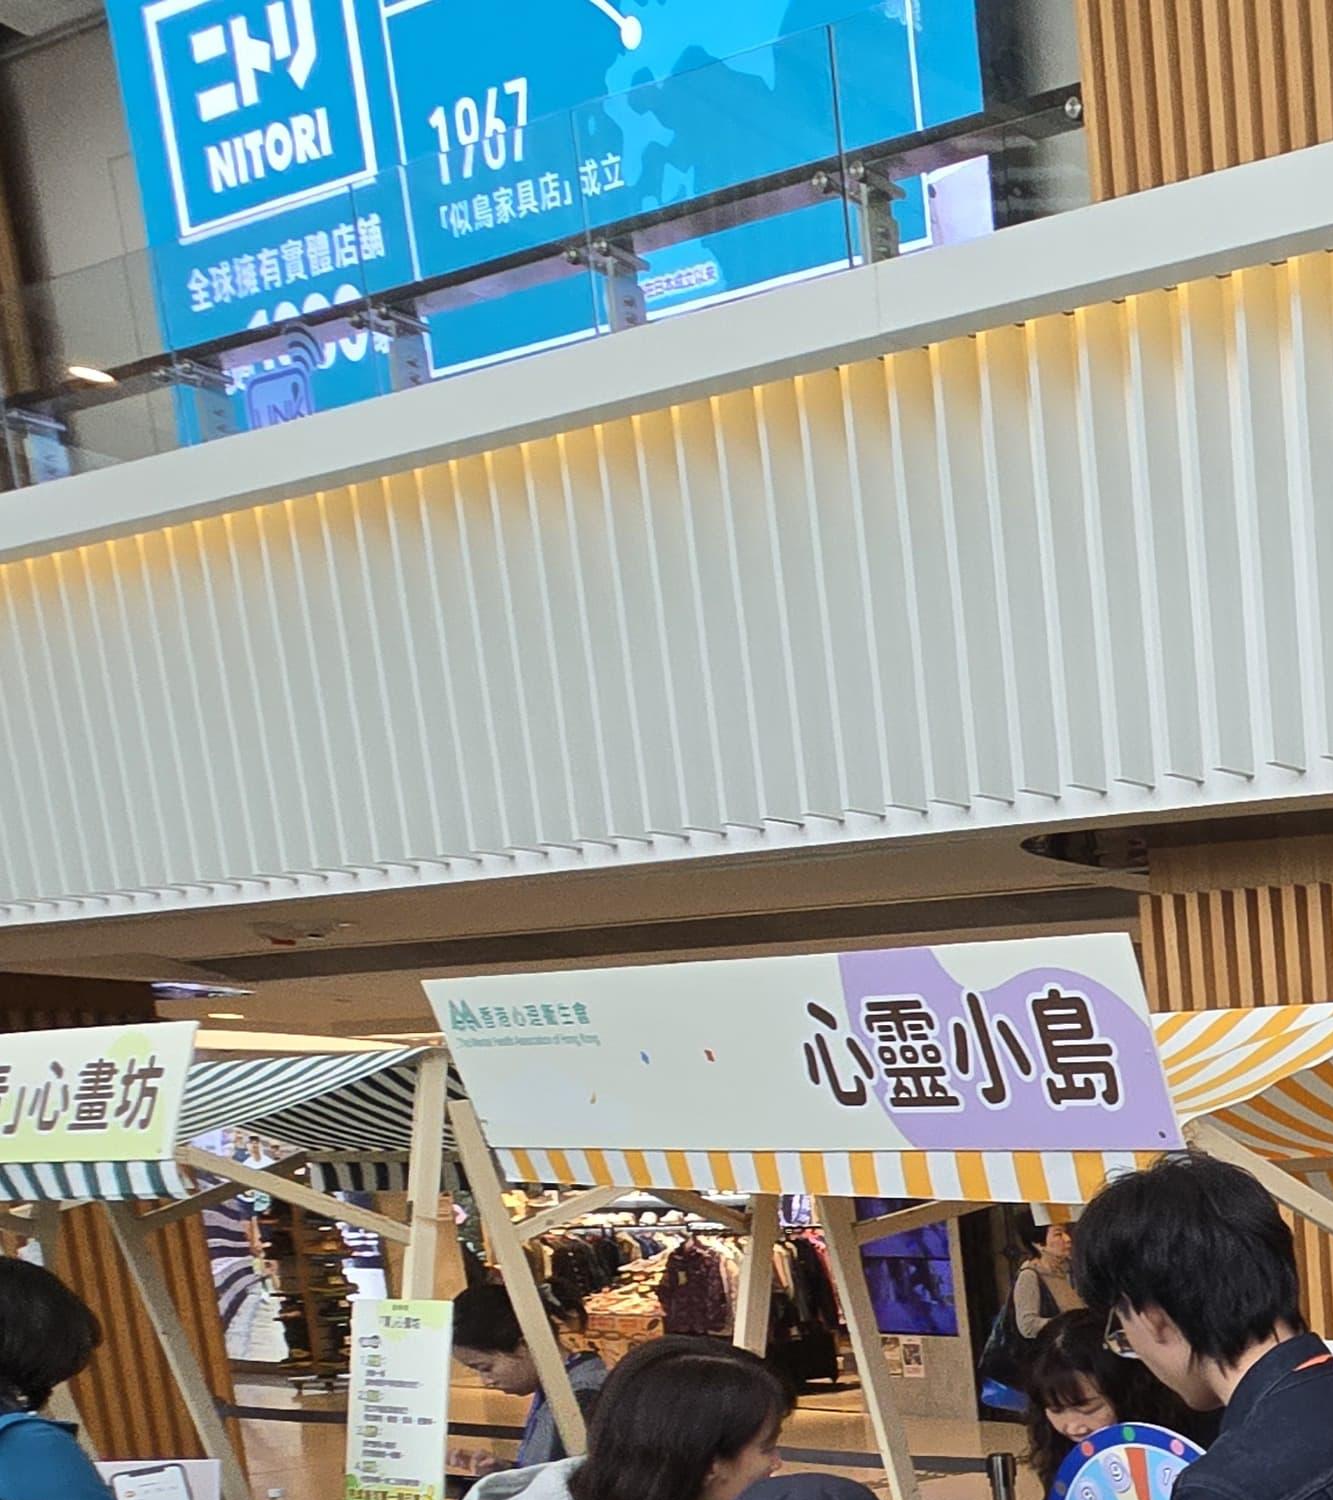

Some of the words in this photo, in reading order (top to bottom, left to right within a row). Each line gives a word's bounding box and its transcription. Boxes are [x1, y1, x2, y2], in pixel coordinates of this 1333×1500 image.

[190, 0, 318, 122] ニトリ
[204, 106, 334, 194] NITORI
[428, 77, 529, 185] 1967
[803, 988, 1122, 1108] 心靈小島
